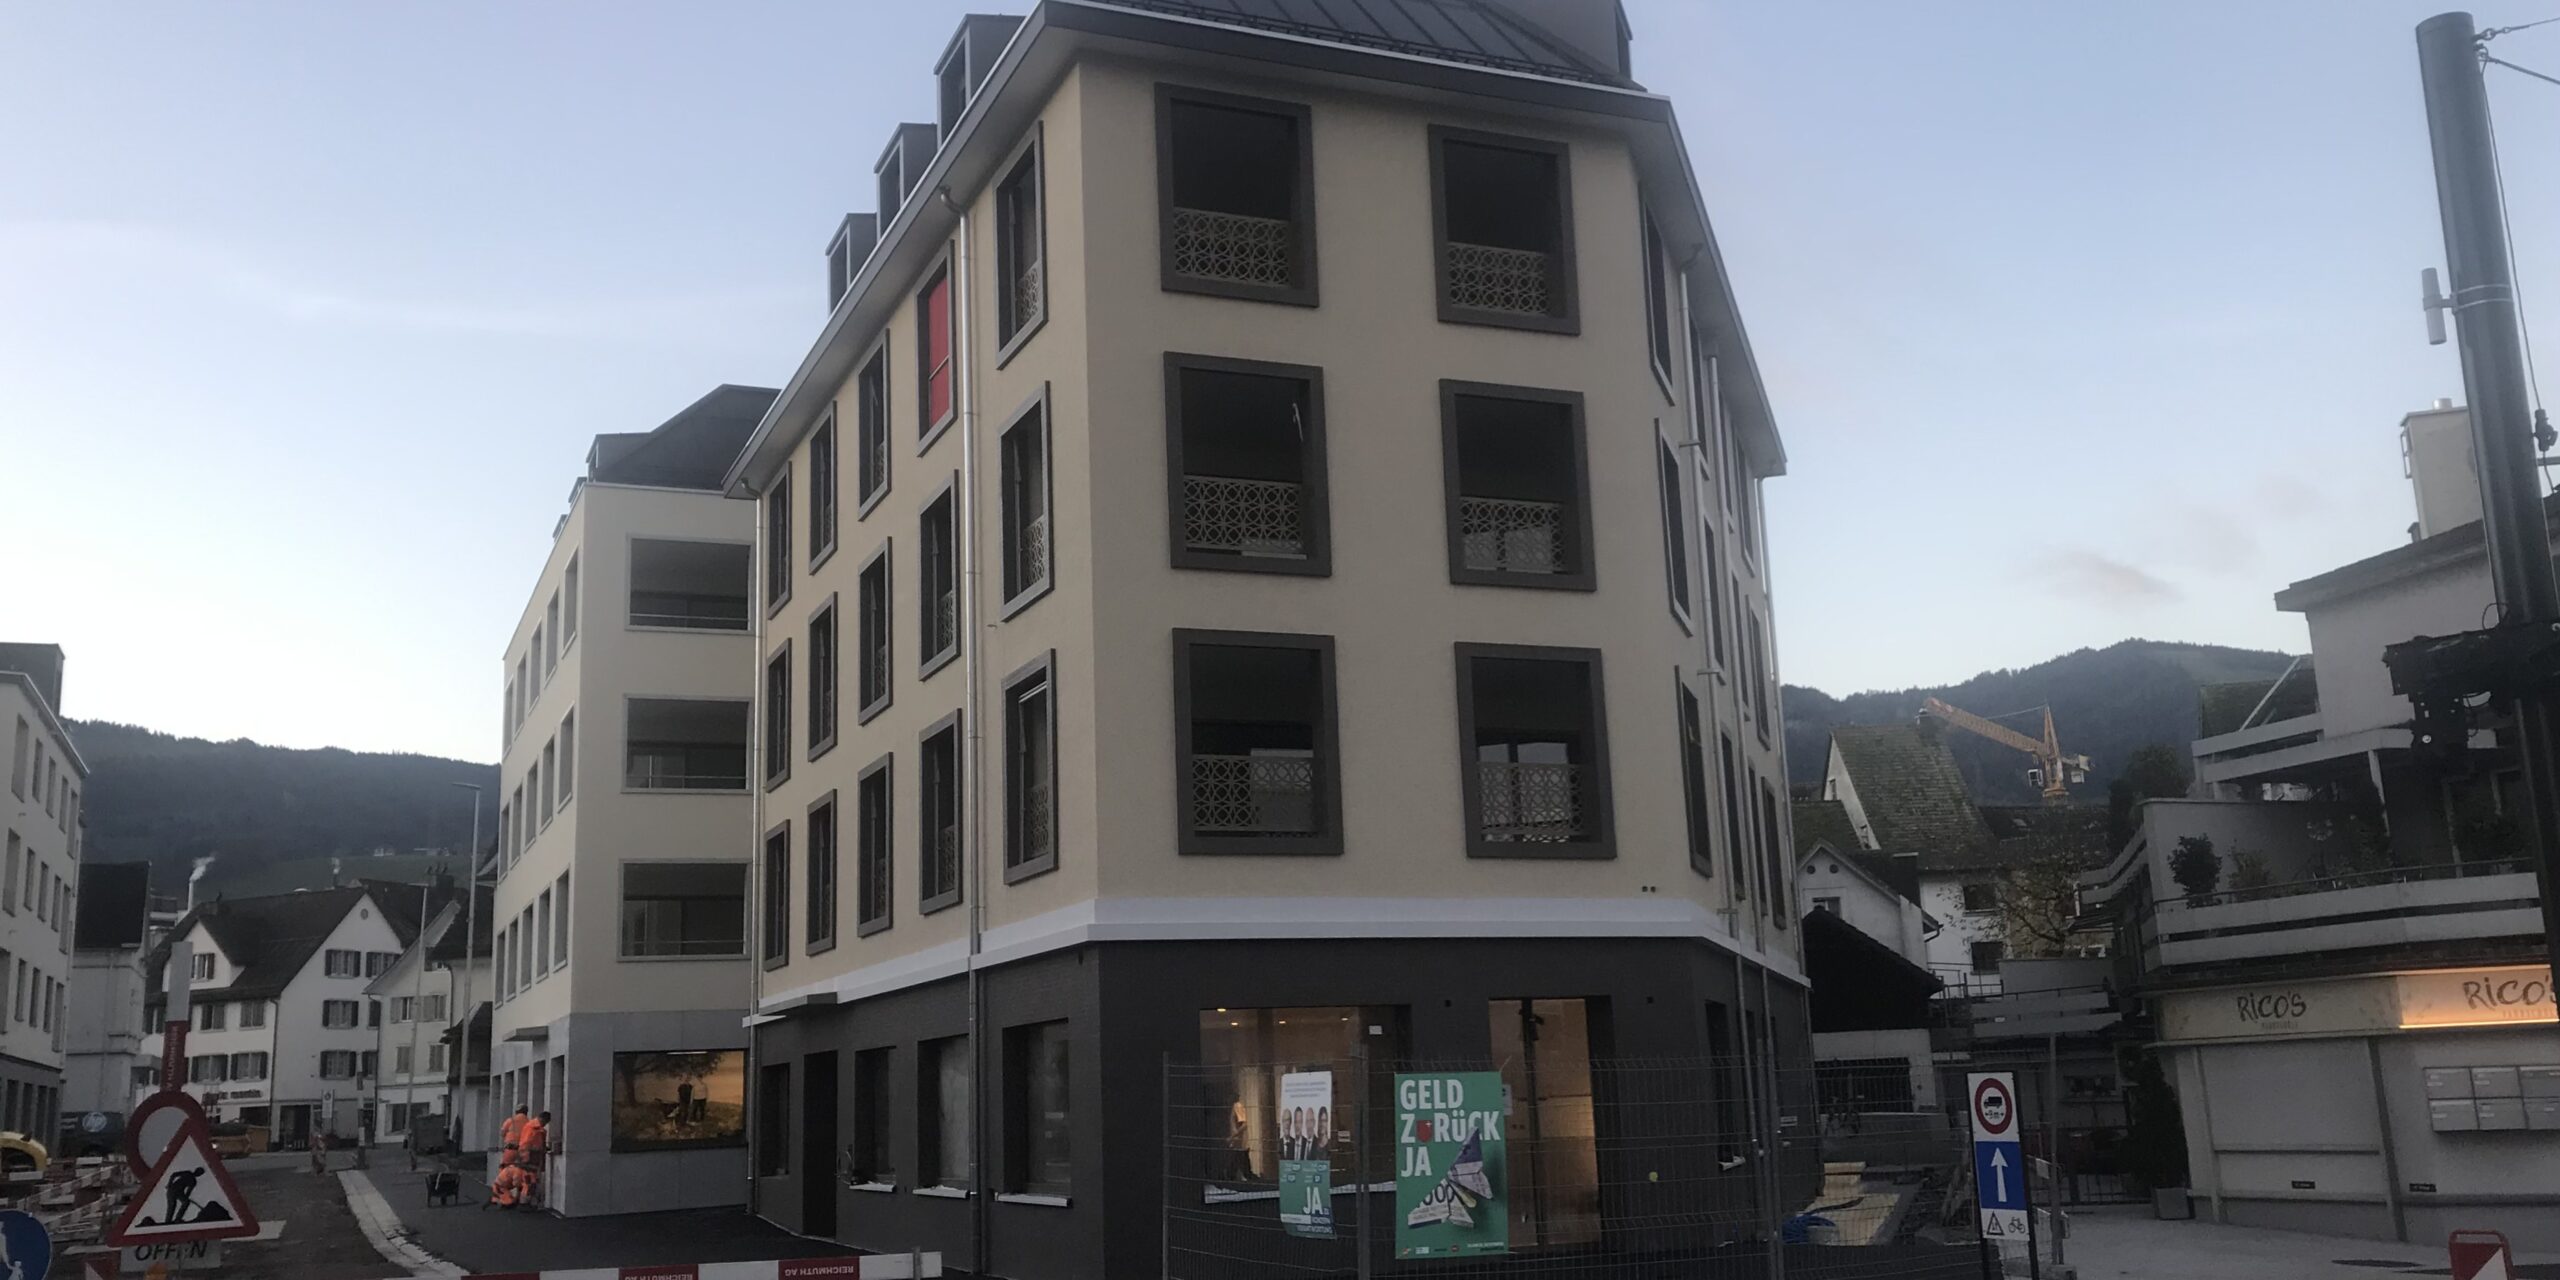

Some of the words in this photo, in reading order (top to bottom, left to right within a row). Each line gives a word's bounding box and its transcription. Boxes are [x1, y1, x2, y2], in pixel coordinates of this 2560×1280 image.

[1400, 1079, 1464, 1111] GELD
[1400, 1146, 1432, 1178] JA
[1303, 1186, 1323, 1214] JA
[784, 1268, 798, 1276] AG
[799, 1265, 854, 1275] REICHMUTH
